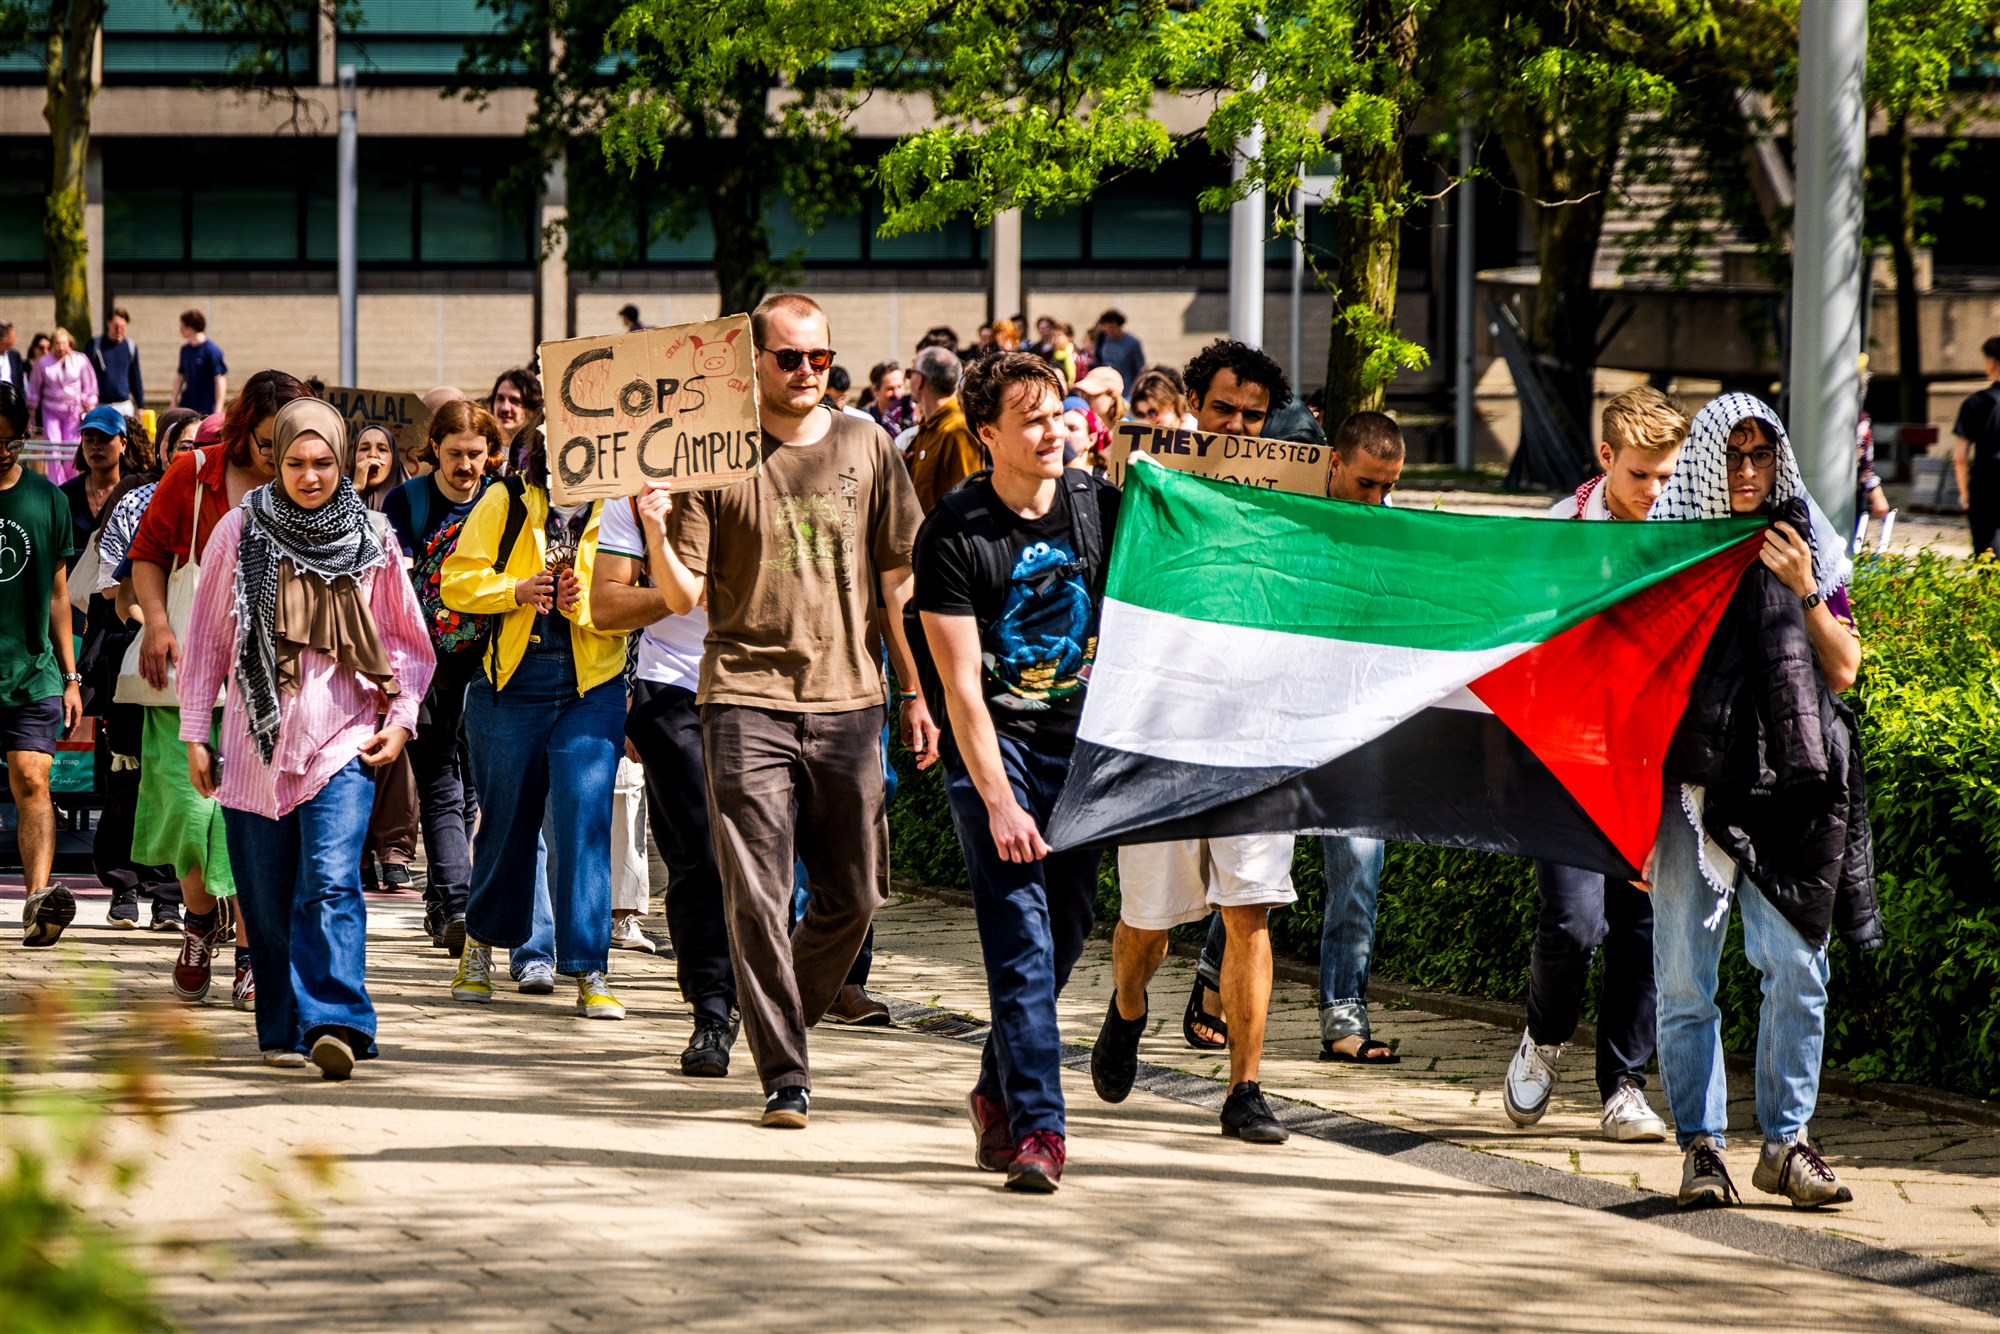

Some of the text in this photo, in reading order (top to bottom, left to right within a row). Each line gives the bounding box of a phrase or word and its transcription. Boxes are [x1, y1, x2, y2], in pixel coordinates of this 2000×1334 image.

[329, 392, 413, 425] HALAL
[558, 418, 759, 487] OFF CAMPUS
[1118, 425, 1321, 465] THEY DIVESTED
[7, 520, 31, 555] FONTEINEN
